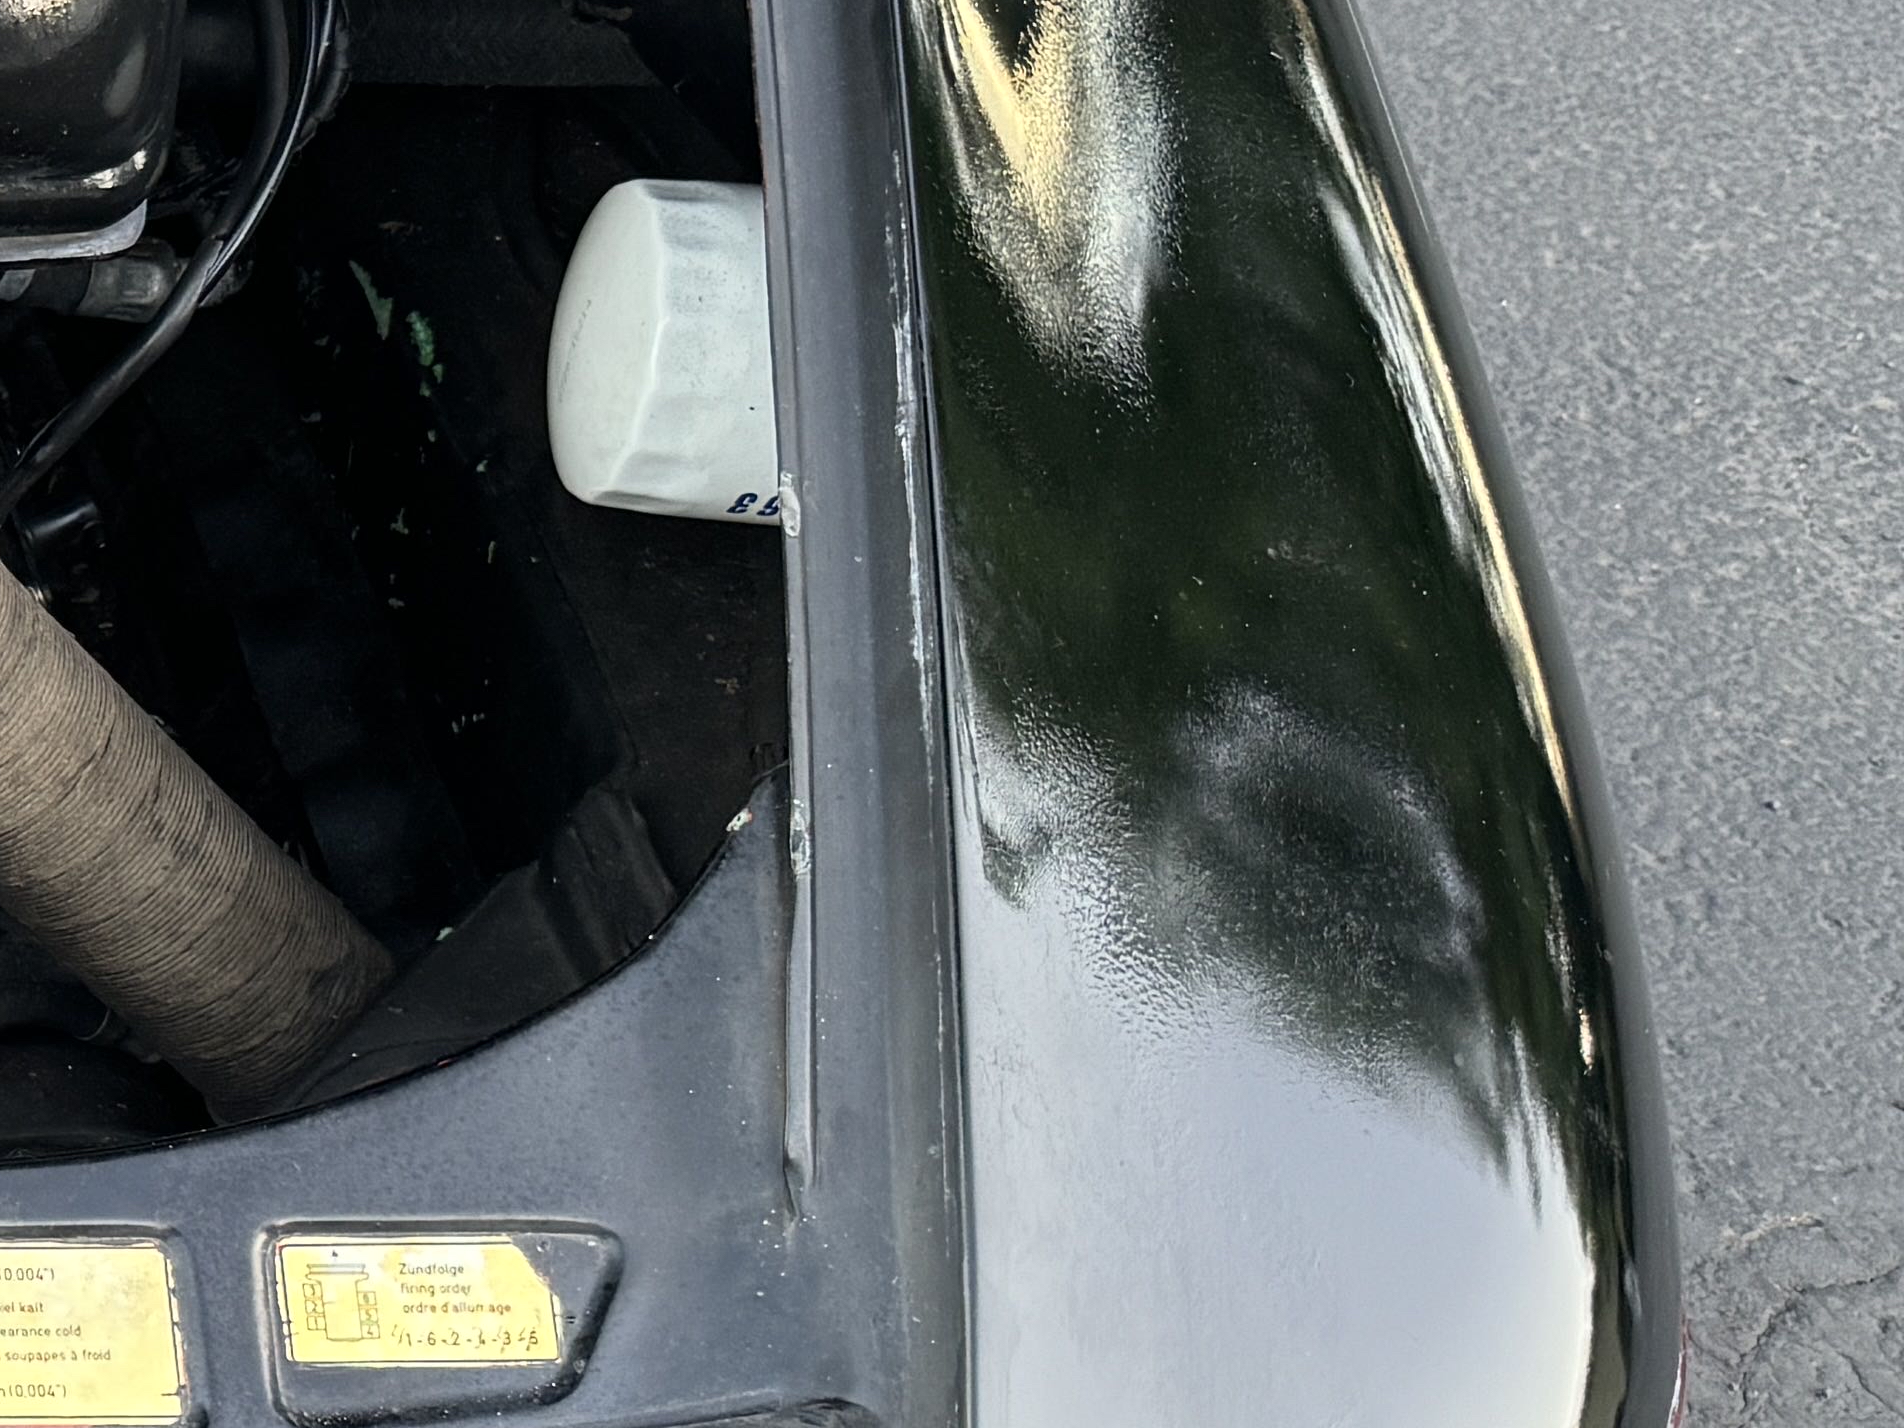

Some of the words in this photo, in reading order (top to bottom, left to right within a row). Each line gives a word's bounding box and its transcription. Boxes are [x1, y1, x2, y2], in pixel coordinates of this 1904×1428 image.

[19, 1302, 44, 1313] kalt
[403, 1302, 436, 1313] ordre
[55, 1325, 82, 1337] cold
[5, 1351, 66, 1363] soupapes
[82, 1349, 111, 1361] froid
